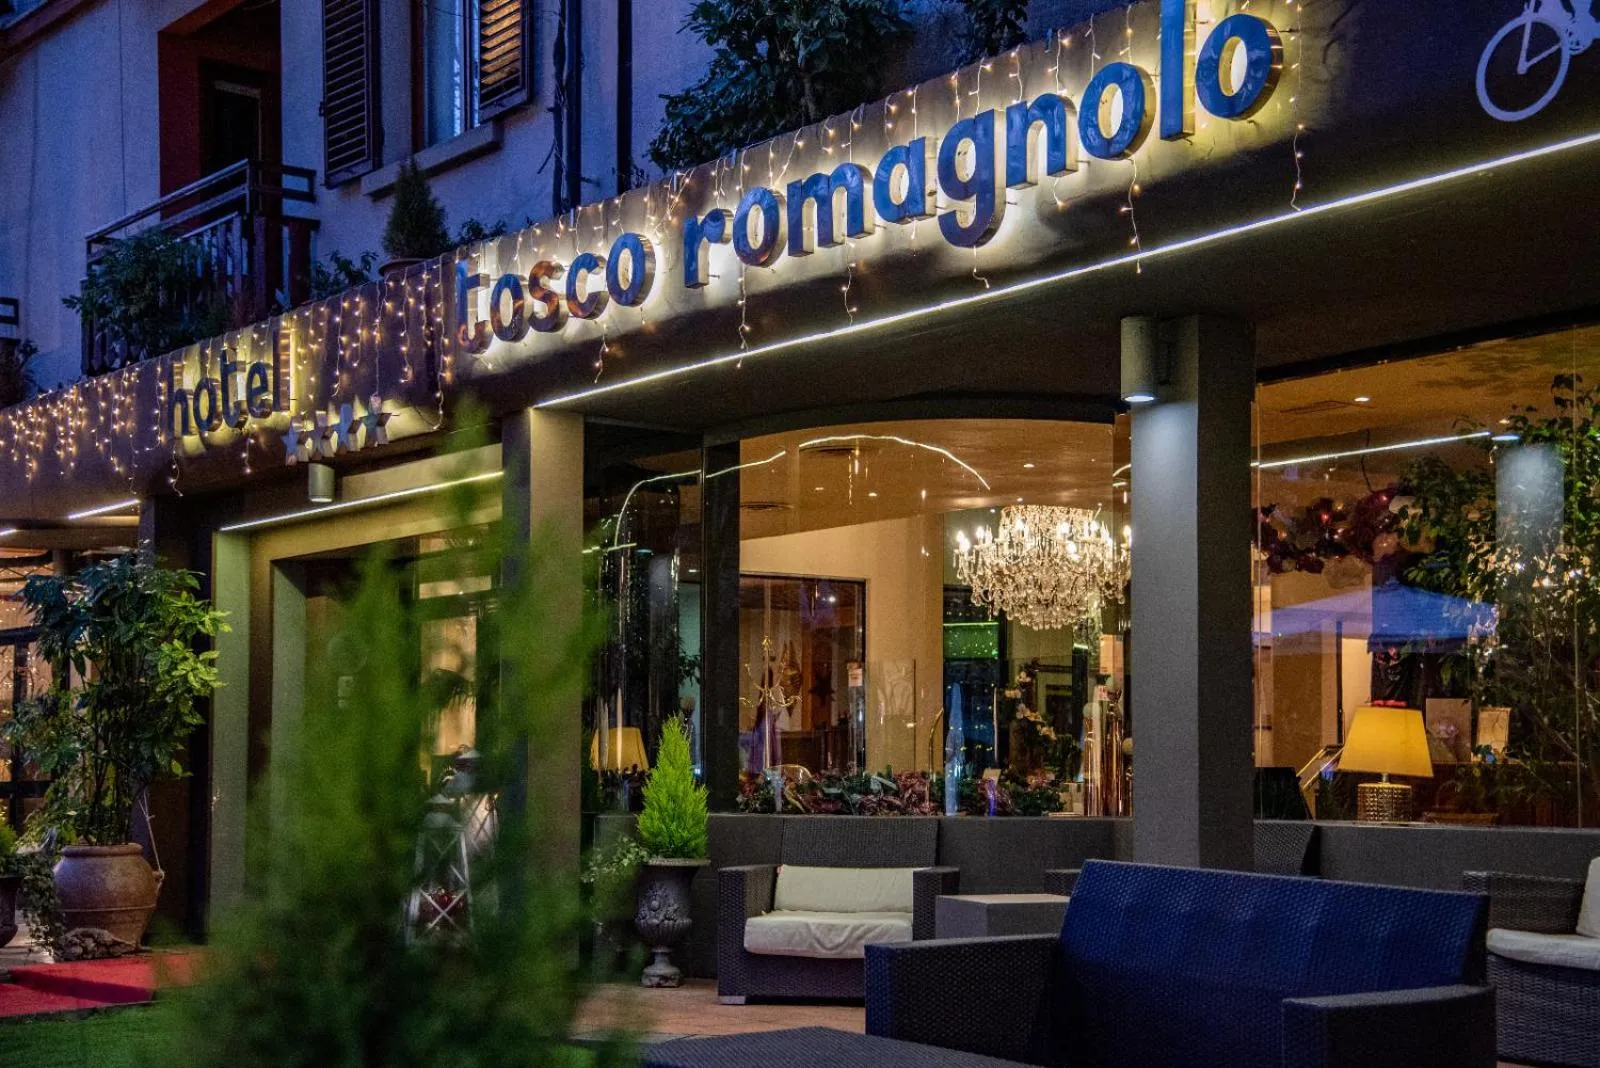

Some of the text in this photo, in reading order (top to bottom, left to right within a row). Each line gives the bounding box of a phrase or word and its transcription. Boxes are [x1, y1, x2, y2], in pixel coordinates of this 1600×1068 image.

[167, 0, 1284, 437] hotel tosco romagnolo
